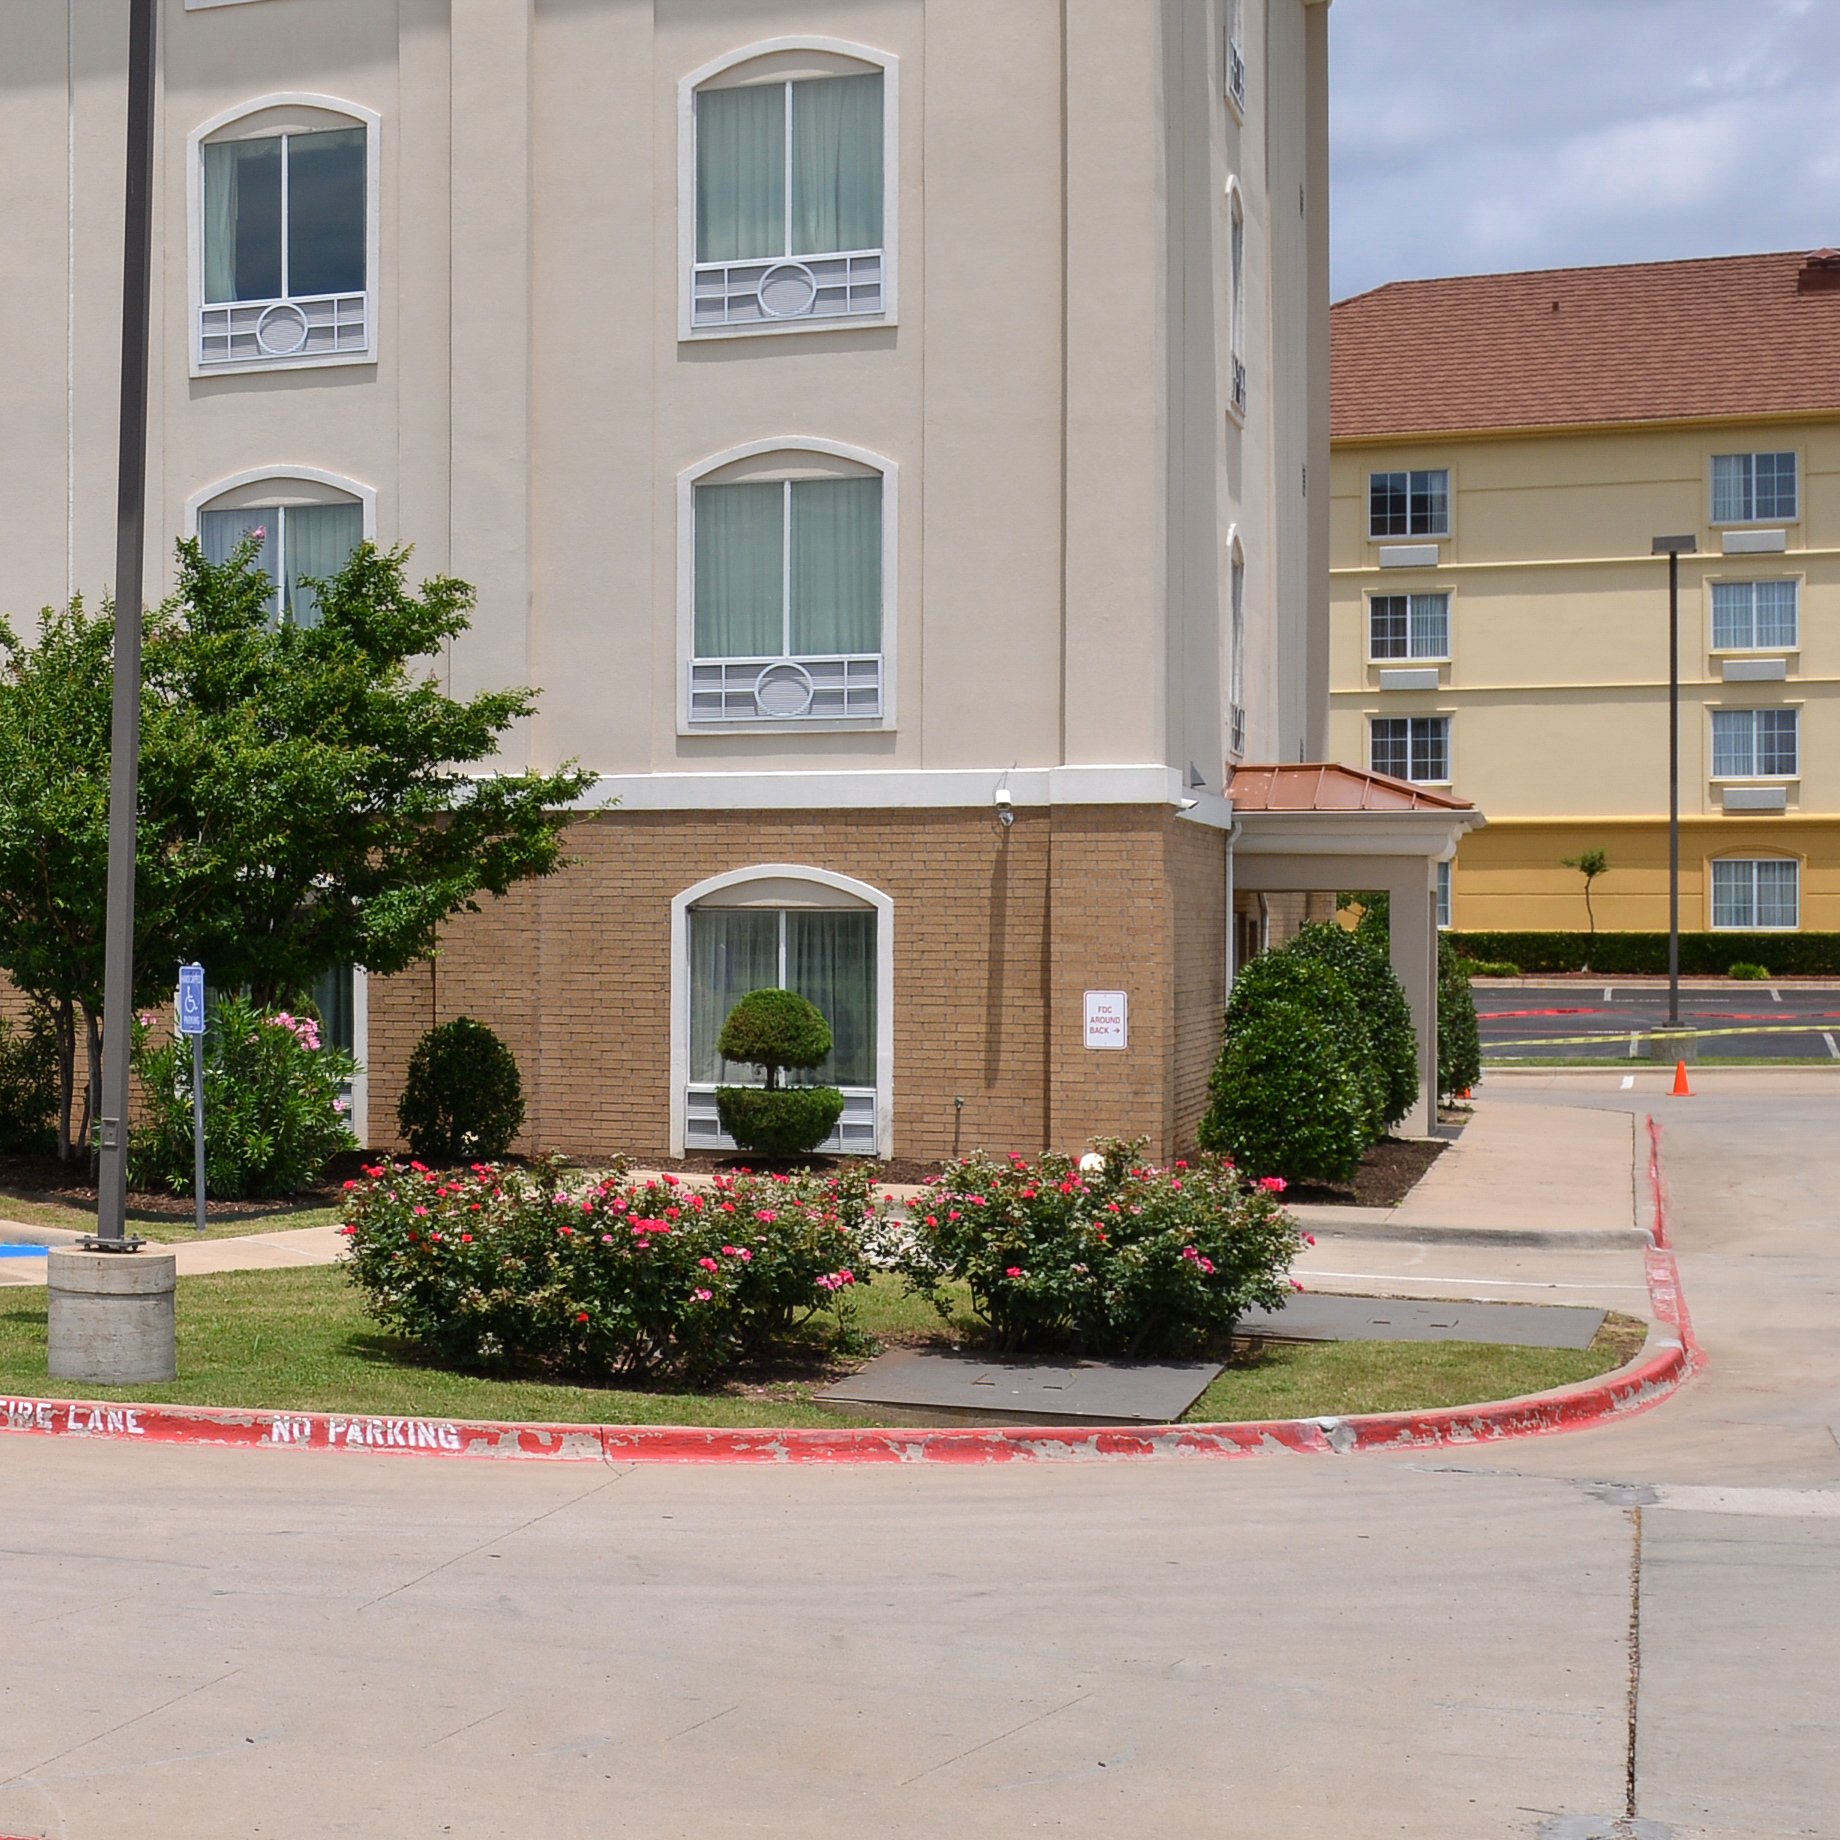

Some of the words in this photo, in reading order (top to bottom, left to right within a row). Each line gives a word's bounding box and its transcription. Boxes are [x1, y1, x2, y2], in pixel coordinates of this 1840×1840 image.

[1097, 1005, 1113, 1014] FDC
[1089, 1015, 1121, 1025] AROUND
[1089, 1026, 1110, 1034] BACK
[66, 1405, 146, 1434] LANE
[270, 1414, 313, 1443] NO
[327, 1416, 462, 1450] PARKING
